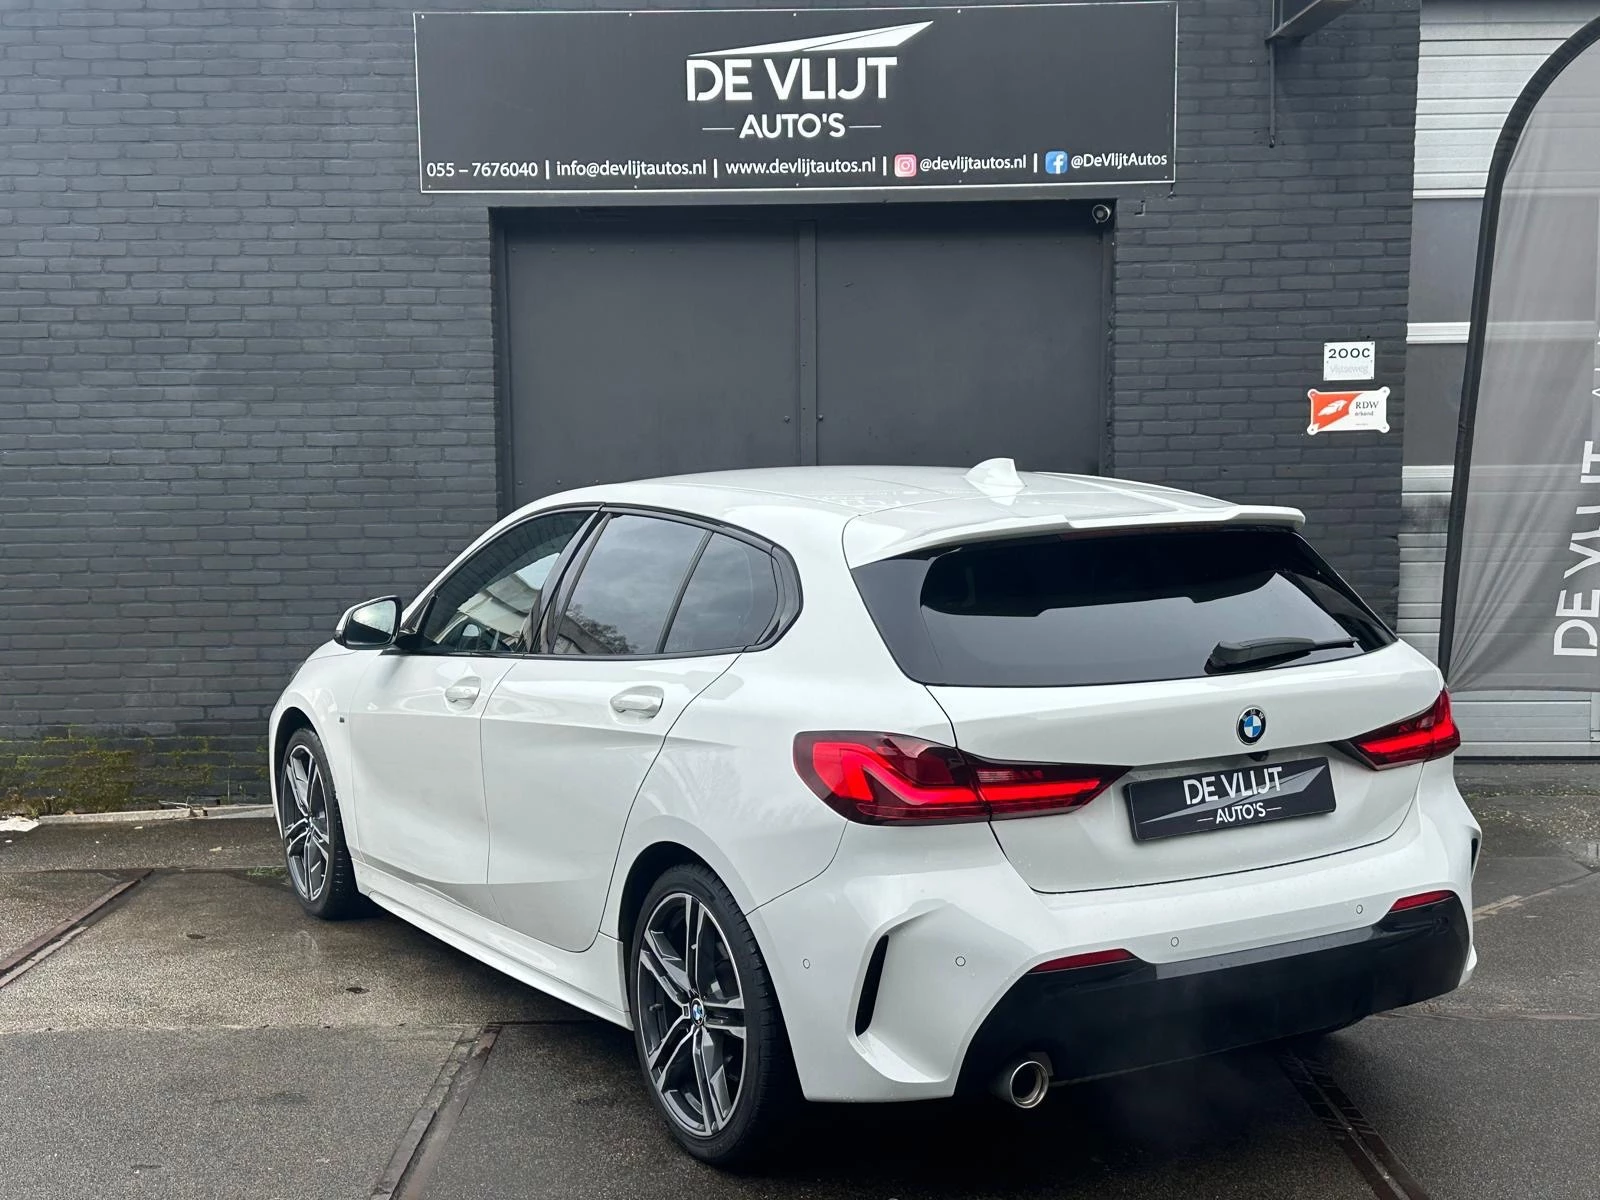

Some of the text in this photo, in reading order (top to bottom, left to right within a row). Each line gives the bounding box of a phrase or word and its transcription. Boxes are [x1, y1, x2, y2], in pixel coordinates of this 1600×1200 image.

[686, 56, 898, 102] DE VLIJT
[738, 112, 846, 139] AUTO'S
[426, 162, 455, 178] 055
[471, 161, 539, 178] 7676040
[556, 159, 707, 179] info@devlijtautos.nl
[725, 157, 876, 177] www.devlijtautos.nl
[919, 154, 1027, 173] @devlijtautos.nl
[1070, 152, 1168, 170] @DeVlijtAutos
[1328, 347, 1371, 359] 200C
[1355, 400, 1379, 410] RDW
[1553, 589, 1600, 657] DE
[1182, 766, 1283, 805] DE VLIJT
[1215, 802, 1267, 825] AUTO'S
